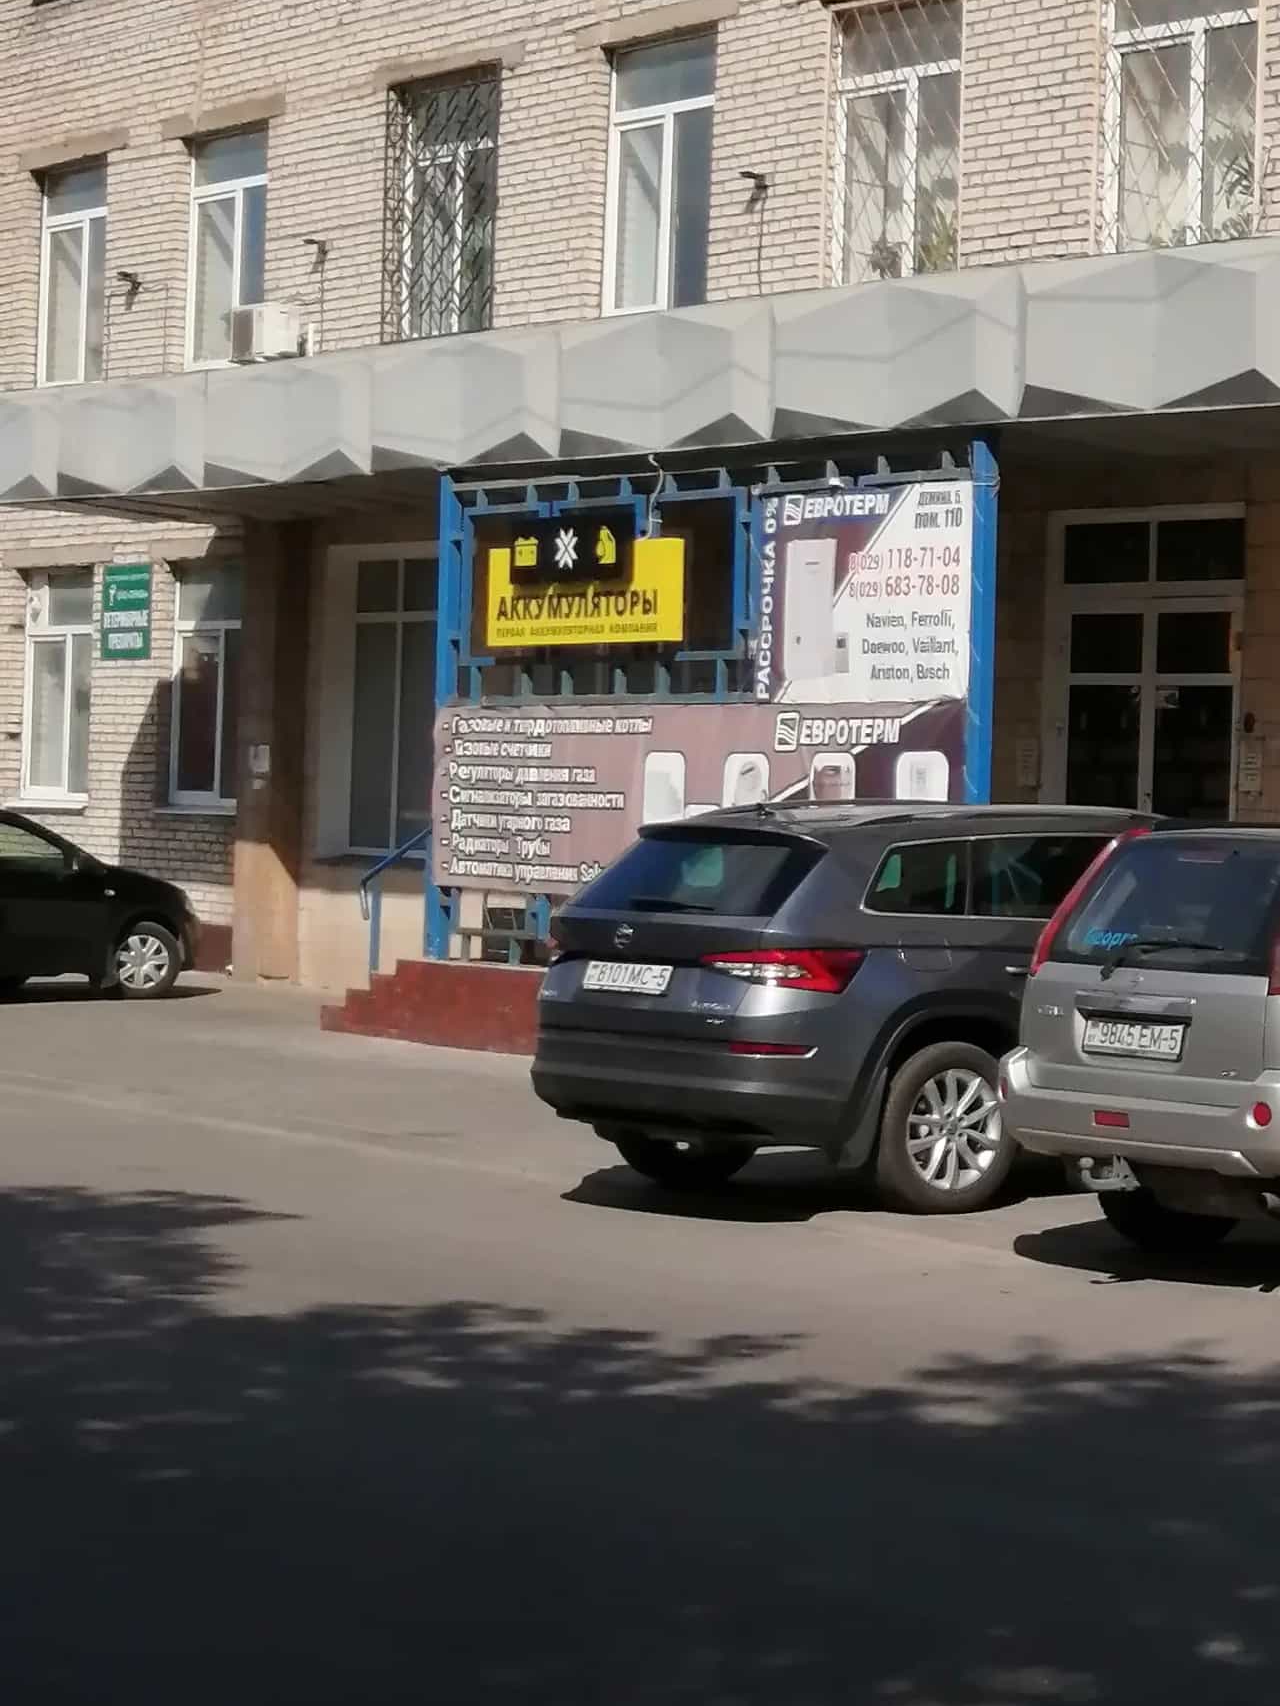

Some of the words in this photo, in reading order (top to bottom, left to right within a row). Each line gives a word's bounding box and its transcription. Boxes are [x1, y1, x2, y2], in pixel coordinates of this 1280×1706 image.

[764, 497, 779, 534] 0%
[803, 493, 890, 519] ЕВРОТЕРМ
[914, 509, 941, 530] ПОМ.
[944, 507, 963, 528] 110
[887, 545, 961, 569] 118-71-04
[884, 574, 960, 598] 683-78-08
[496, 588, 658, 622] АККУМУЛЯТОРЫ
[756, 539, 776, 700] РАССРОЧКА
[865, 611, 908, 631] Navien,
[861, 639, 909, 657] Daewoo,
[912, 637, 960, 657] Vaillant,
[916, 663, 950, 681] Bosch
[451, 716, 503, 734] Газовые
[614, 716, 653, 734] котлы
[799, 715, 902, 745] ЕВРОТЕРМ
[449, 762, 515, 784] Регуляторы
[571, 767, 597, 783] газа
[450, 809, 498, 832] Датчики
[544, 815, 571, 832] газа
[515, 836, 551, 859] Трубы
